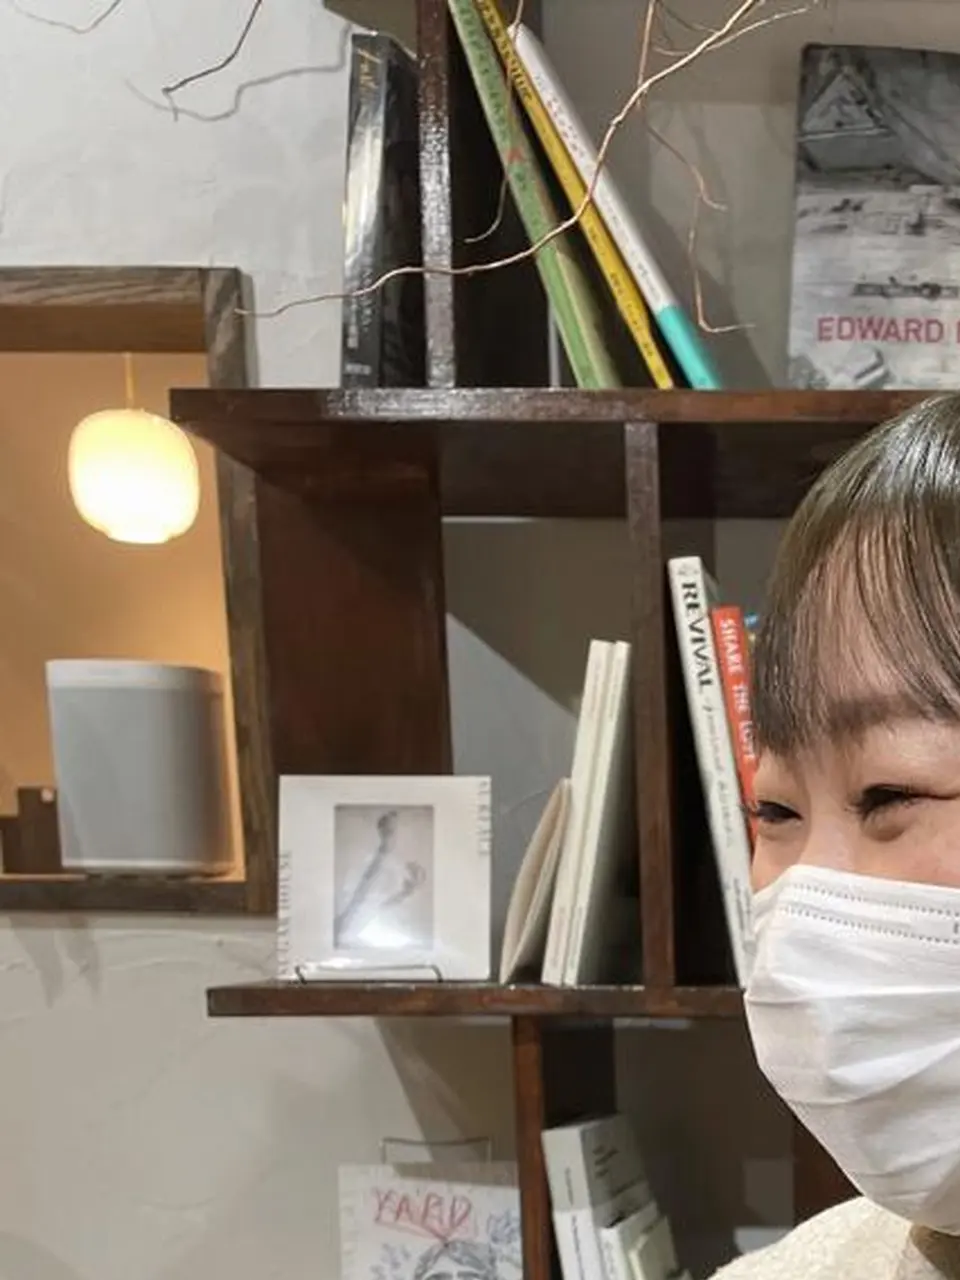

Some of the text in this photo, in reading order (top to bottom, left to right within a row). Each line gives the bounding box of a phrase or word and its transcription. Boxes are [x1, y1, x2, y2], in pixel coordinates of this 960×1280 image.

[817, 316, 944, 343] EDWARD
[681, 581, 714, 695] REVIVAL
[720, 618, 745, 677] SHARE
